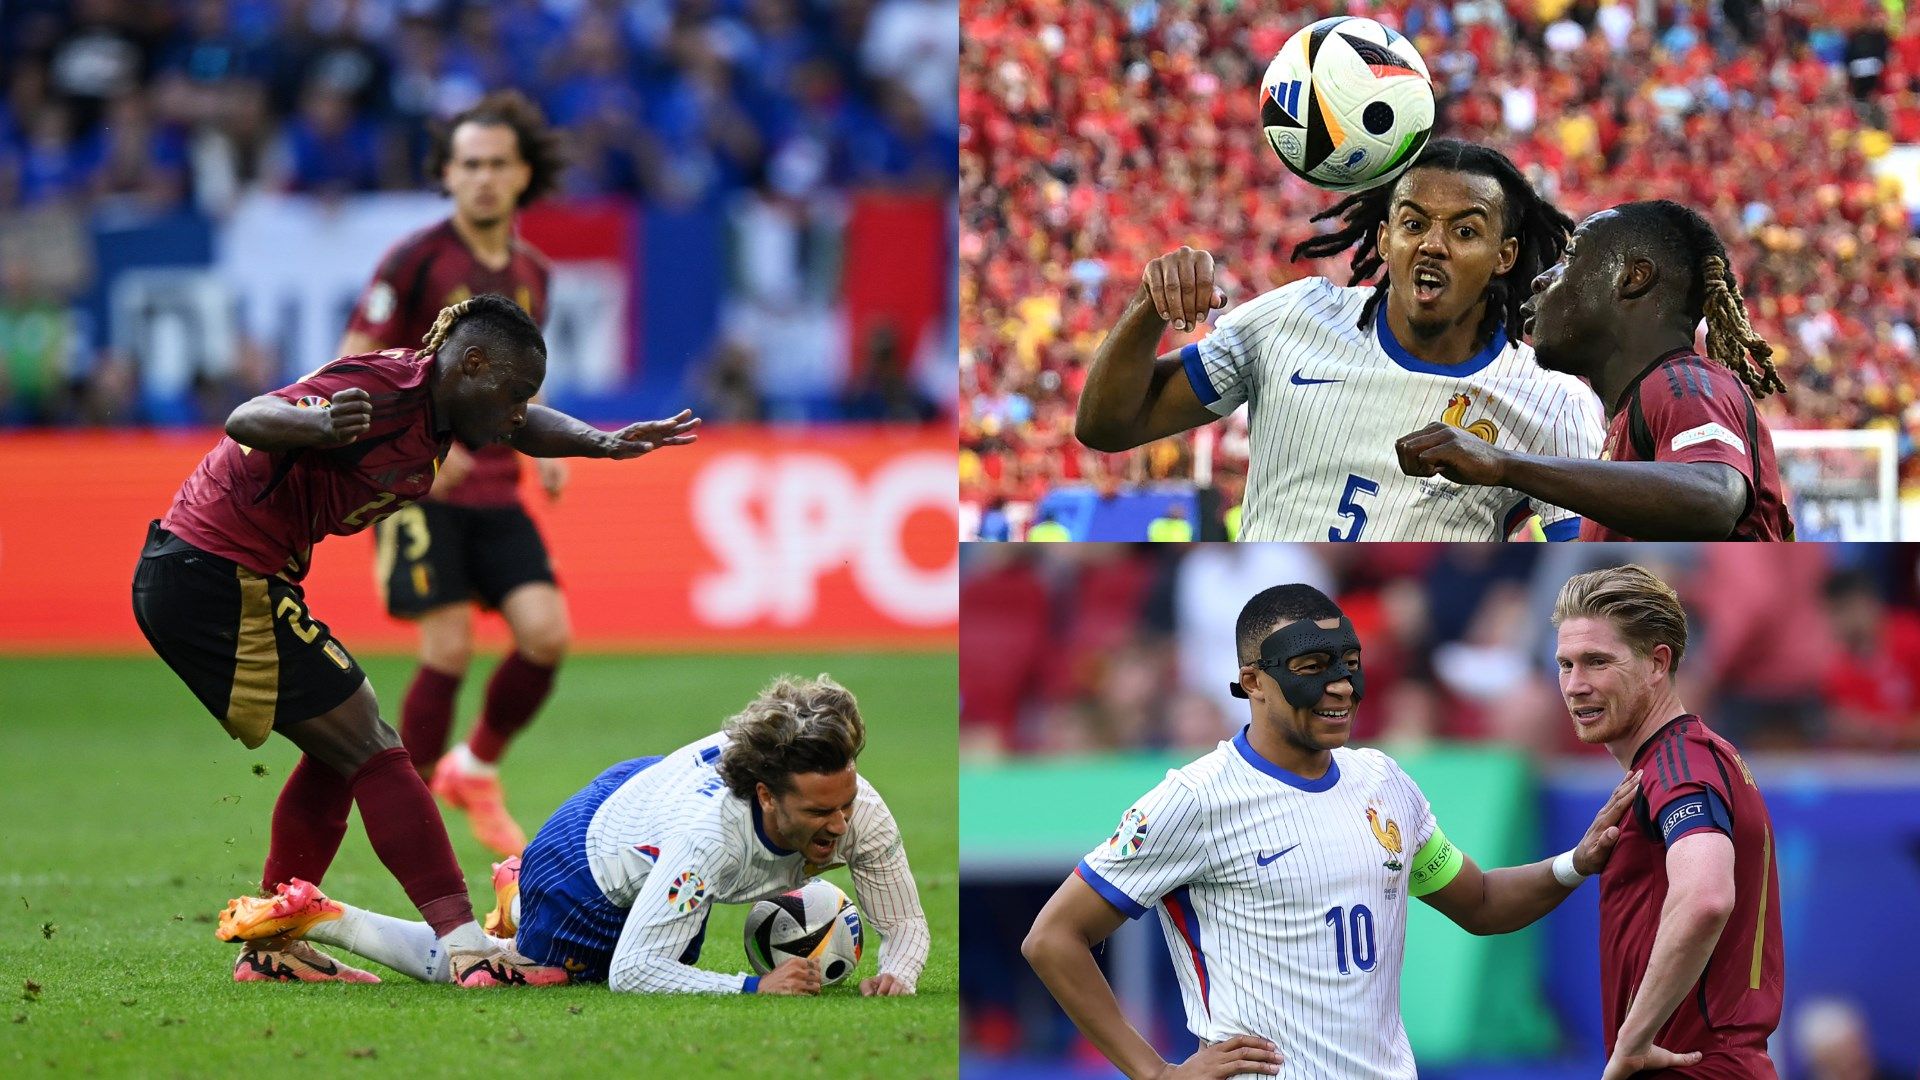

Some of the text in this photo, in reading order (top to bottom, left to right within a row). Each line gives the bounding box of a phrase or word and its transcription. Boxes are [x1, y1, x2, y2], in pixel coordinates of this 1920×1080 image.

[691, 451, 958, 627] SPO
[1328, 474, 1380, 542] 5
[1325, 904, 1377, 975] 10
